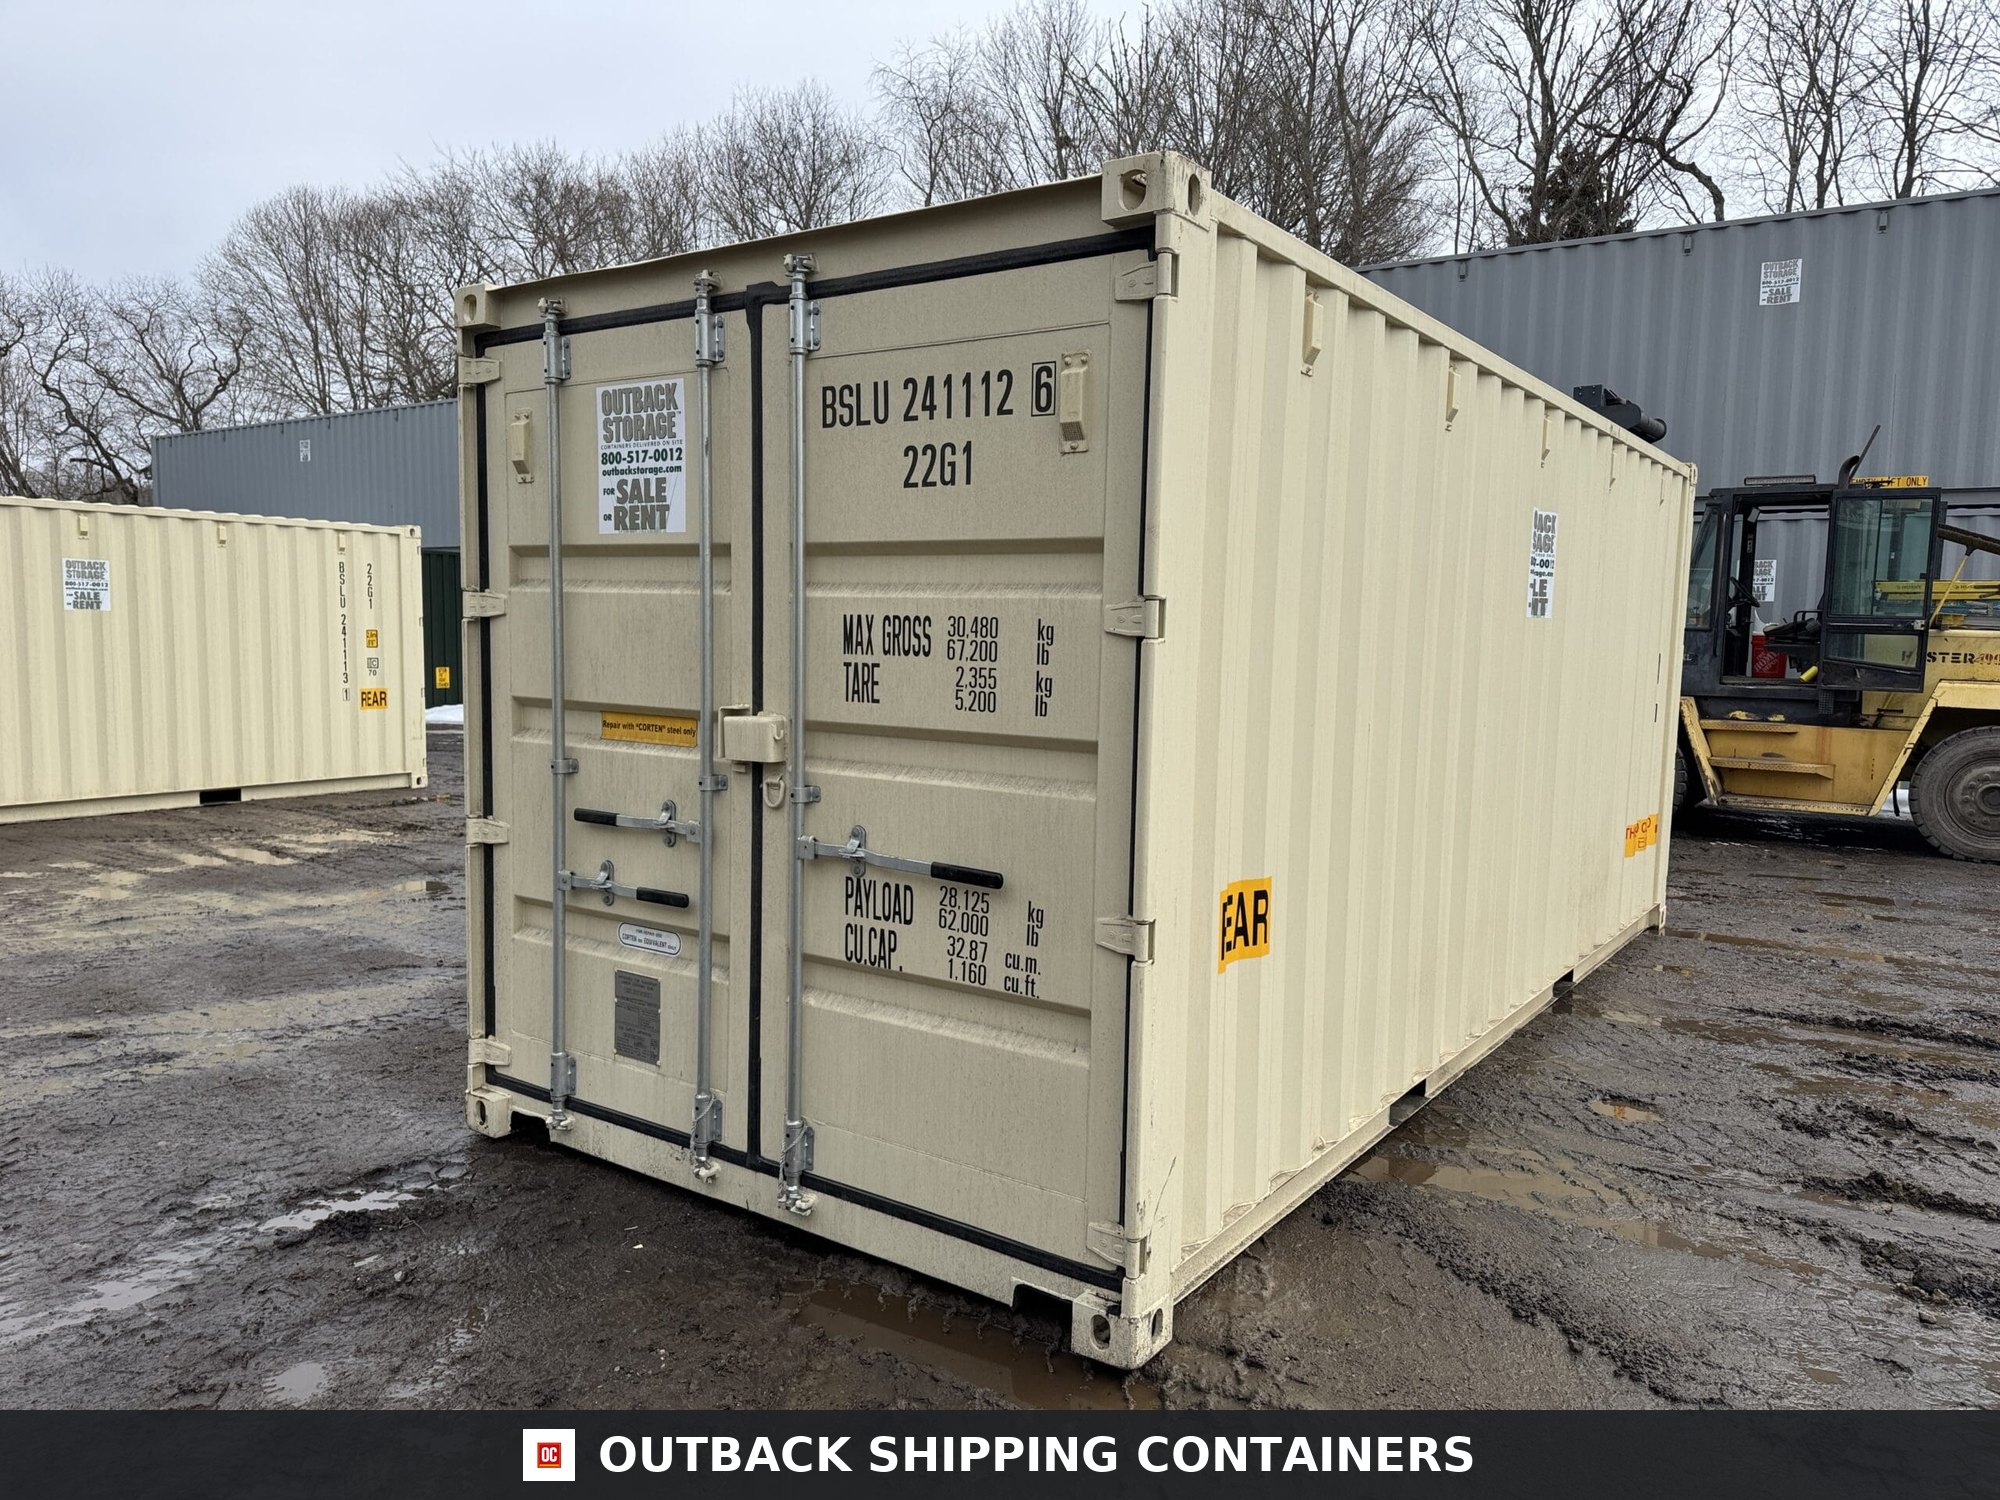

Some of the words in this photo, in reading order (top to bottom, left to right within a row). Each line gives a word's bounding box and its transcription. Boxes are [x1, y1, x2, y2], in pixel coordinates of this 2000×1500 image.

[1767, 294, 1792, 304] RENT
[1768, 286, 1791, 296] SALE
[601, 383, 678, 416] OUTBACK
[822, 380, 889, 428] BSLU
[903, 369, 1013, 422] 241112
[603, 411, 676, 443] STORAGE
[601, 448, 682, 465] 800-517-0012
[903, 441, 972, 488] 22G1
[602, 466, 682, 476] outbackstorage.com
[1906, 476, 1927, 486] ONLY
[603, 488, 615, 496] FOR
[616, 477, 667, 504] SALE
[604, 514, 612, 522] OR
[614, 504, 670, 530] RENT
[65, 560, 106, 570] OUTBACK
[66, 570, 105, 580] STORAGE
[72, 600, 102, 610] RENT
[74, 591, 100, 600] SALE
[843, 614, 874, 656] MAX
[882, 614, 932, 657] GROSS
[948, 616, 998, 638] 30,480
[1038, 618, 1054, 646] kg
[947, 639, 998, 662] 67,200
[1036, 642, 1050, 665] lb
[843, 662, 880, 704] TARE
[956, 666, 997, 690] 2,355
[1036, 670, 1052, 698] kg
[361, 690, 387, 707] REAR
[955, 689, 996, 712] 5,200
[1035, 694, 1048, 716] lb
[602, 720, 620, 730] Repair
[622, 722, 634, 730] with
[666, 726, 682, 734] steel
[683, 728, 696, 737] only
[845, 876, 914, 926] PAYLOAD
[939, 886, 990, 914] 28,125
[1028, 901, 1044, 929] kg
[938, 908, 988, 936] 62,000
[1026, 924, 1039, 947] lb
[845, 923, 903, 972] CU.CAP.
[947, 936, 988, 963] 32.87
[1005, 952, 1041, 975] cu.m.
[948, 958, 986, 986] 1,160
[1004, 975, 1040, 999] cu.ft.
